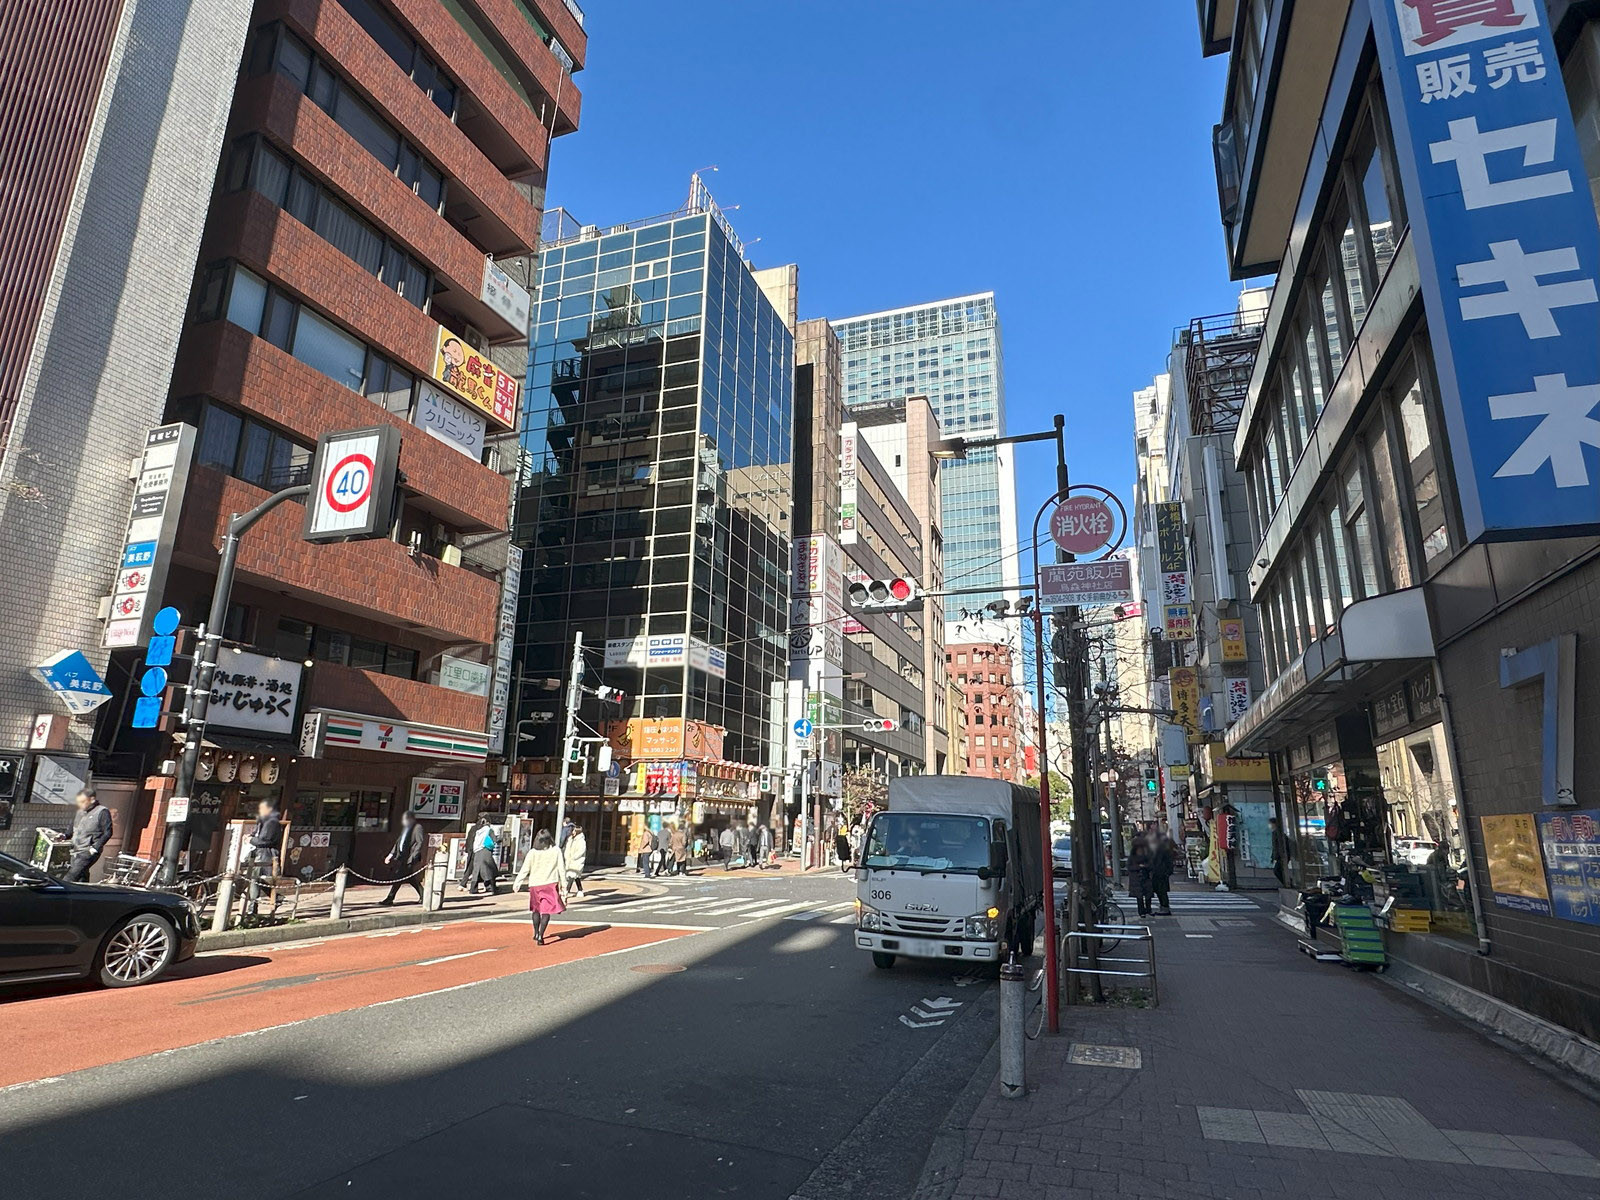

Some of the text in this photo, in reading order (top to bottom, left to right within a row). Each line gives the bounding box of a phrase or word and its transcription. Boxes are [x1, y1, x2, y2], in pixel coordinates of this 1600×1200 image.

[1416, 39, 1546, 104] 販売
[1428, 116, 1600, 489] セキネ
[497, 374, 515, 392] 5F
[495, 390, 513, 408] セット
[441, 398, 482, 433] にじいろ
[493, 403, 512, 424] 専用
[424, 408, 476, 446] クリニック
[336, 469, 365, 496] 40
[1060, 502, 1101, 512] FIRE HYDRANT
[1056, 511, 1108, 538] 消火栓
[1157, 504, 1171, 563] ハイボール
[1047, 564, 1124, 583] 蘭苑飯店
[1166, 562, 1180, 571] 4F
[443, 663, 488, 684] 江里口歯科
[69, 679, 103, 692] 美萩野
[83, 699, 97, 708] 3F
[440, 805, 456, 814] ATM
[871, 890, 892, 900] 306
